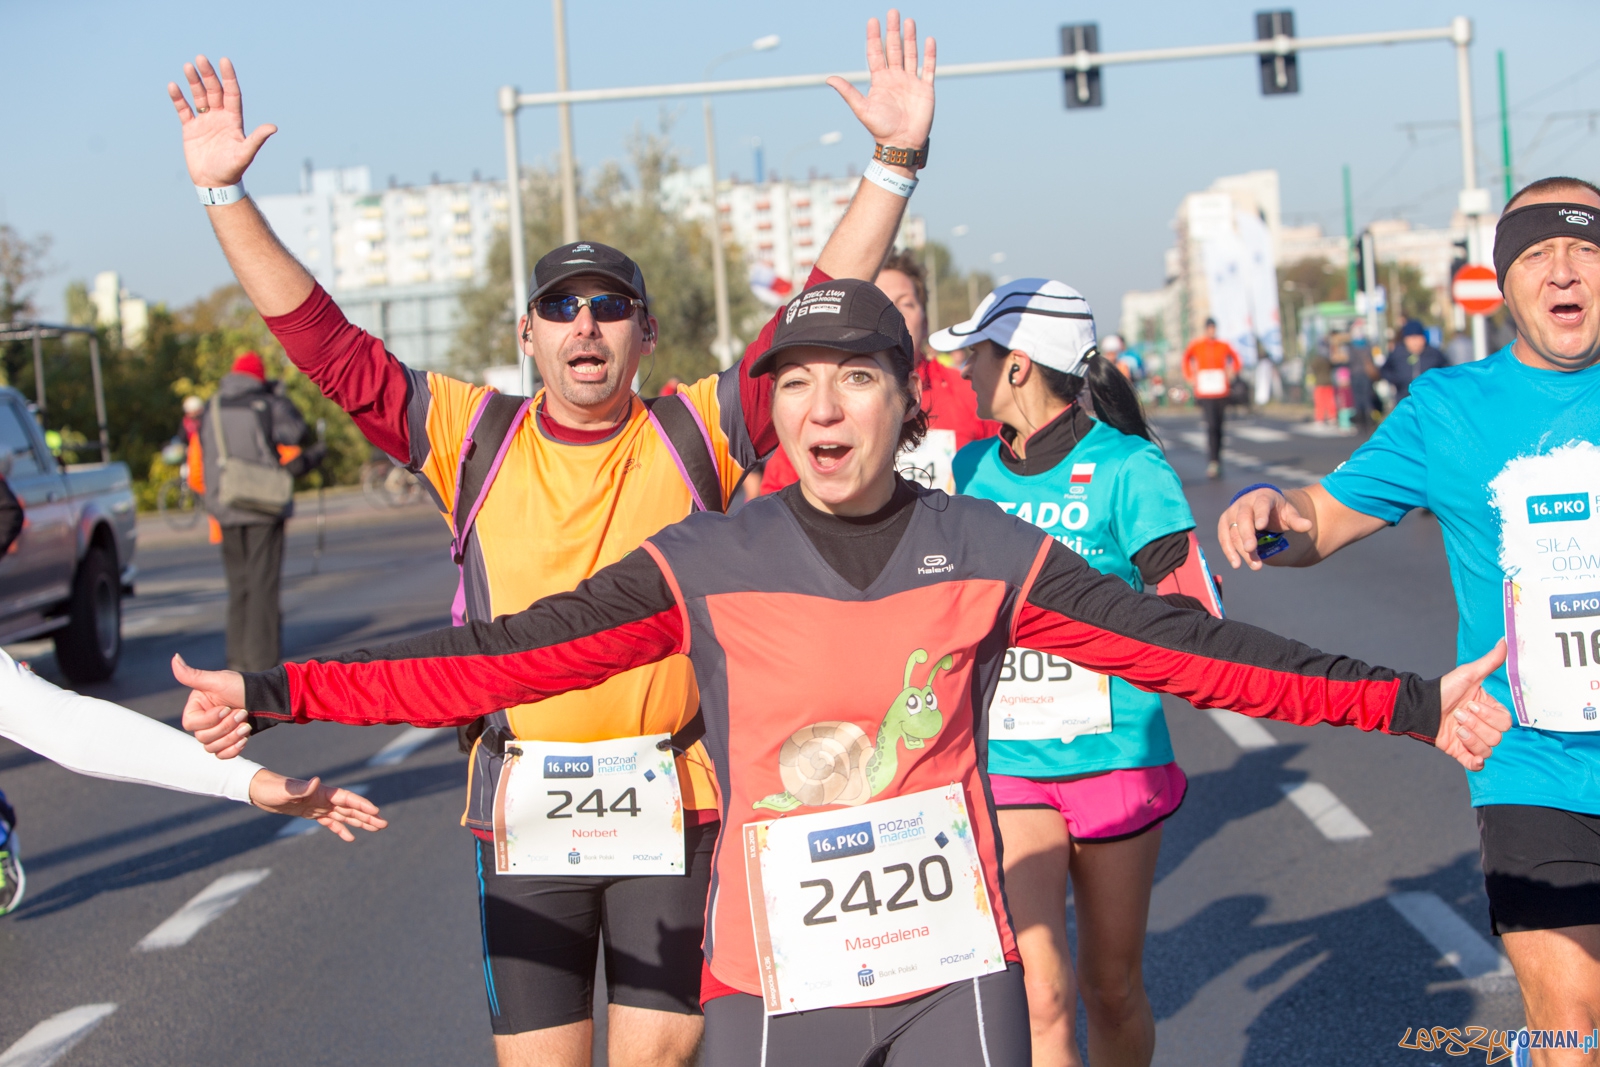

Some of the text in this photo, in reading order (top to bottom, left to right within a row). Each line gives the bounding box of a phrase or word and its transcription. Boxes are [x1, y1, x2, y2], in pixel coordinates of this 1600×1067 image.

[1531, 502, 1553, 516] 16.
[1554, 499, 1585, 514] PKO
[1536, 536, 1581, 554] SIŁA
[917, 563, 954, 575] Kalenji
[1554, 598, 1600, 613] 16. PKO
[1000, 695, 1054, 705] Agnieszka
[547, 761, 589, 773] 16. PKO
[598, 763, 637, 773] maraton
[546, 786, 642, 820] 244
[572, 828, 618, 838] Norbert
[880, 826, 925, 844] maraton
[813, 838, 836, 854] 16.
[837, 830, 869, 850] PKO
[799, 854, 954, 927] 2420
[845, 926, 930, 951] Magdalena
